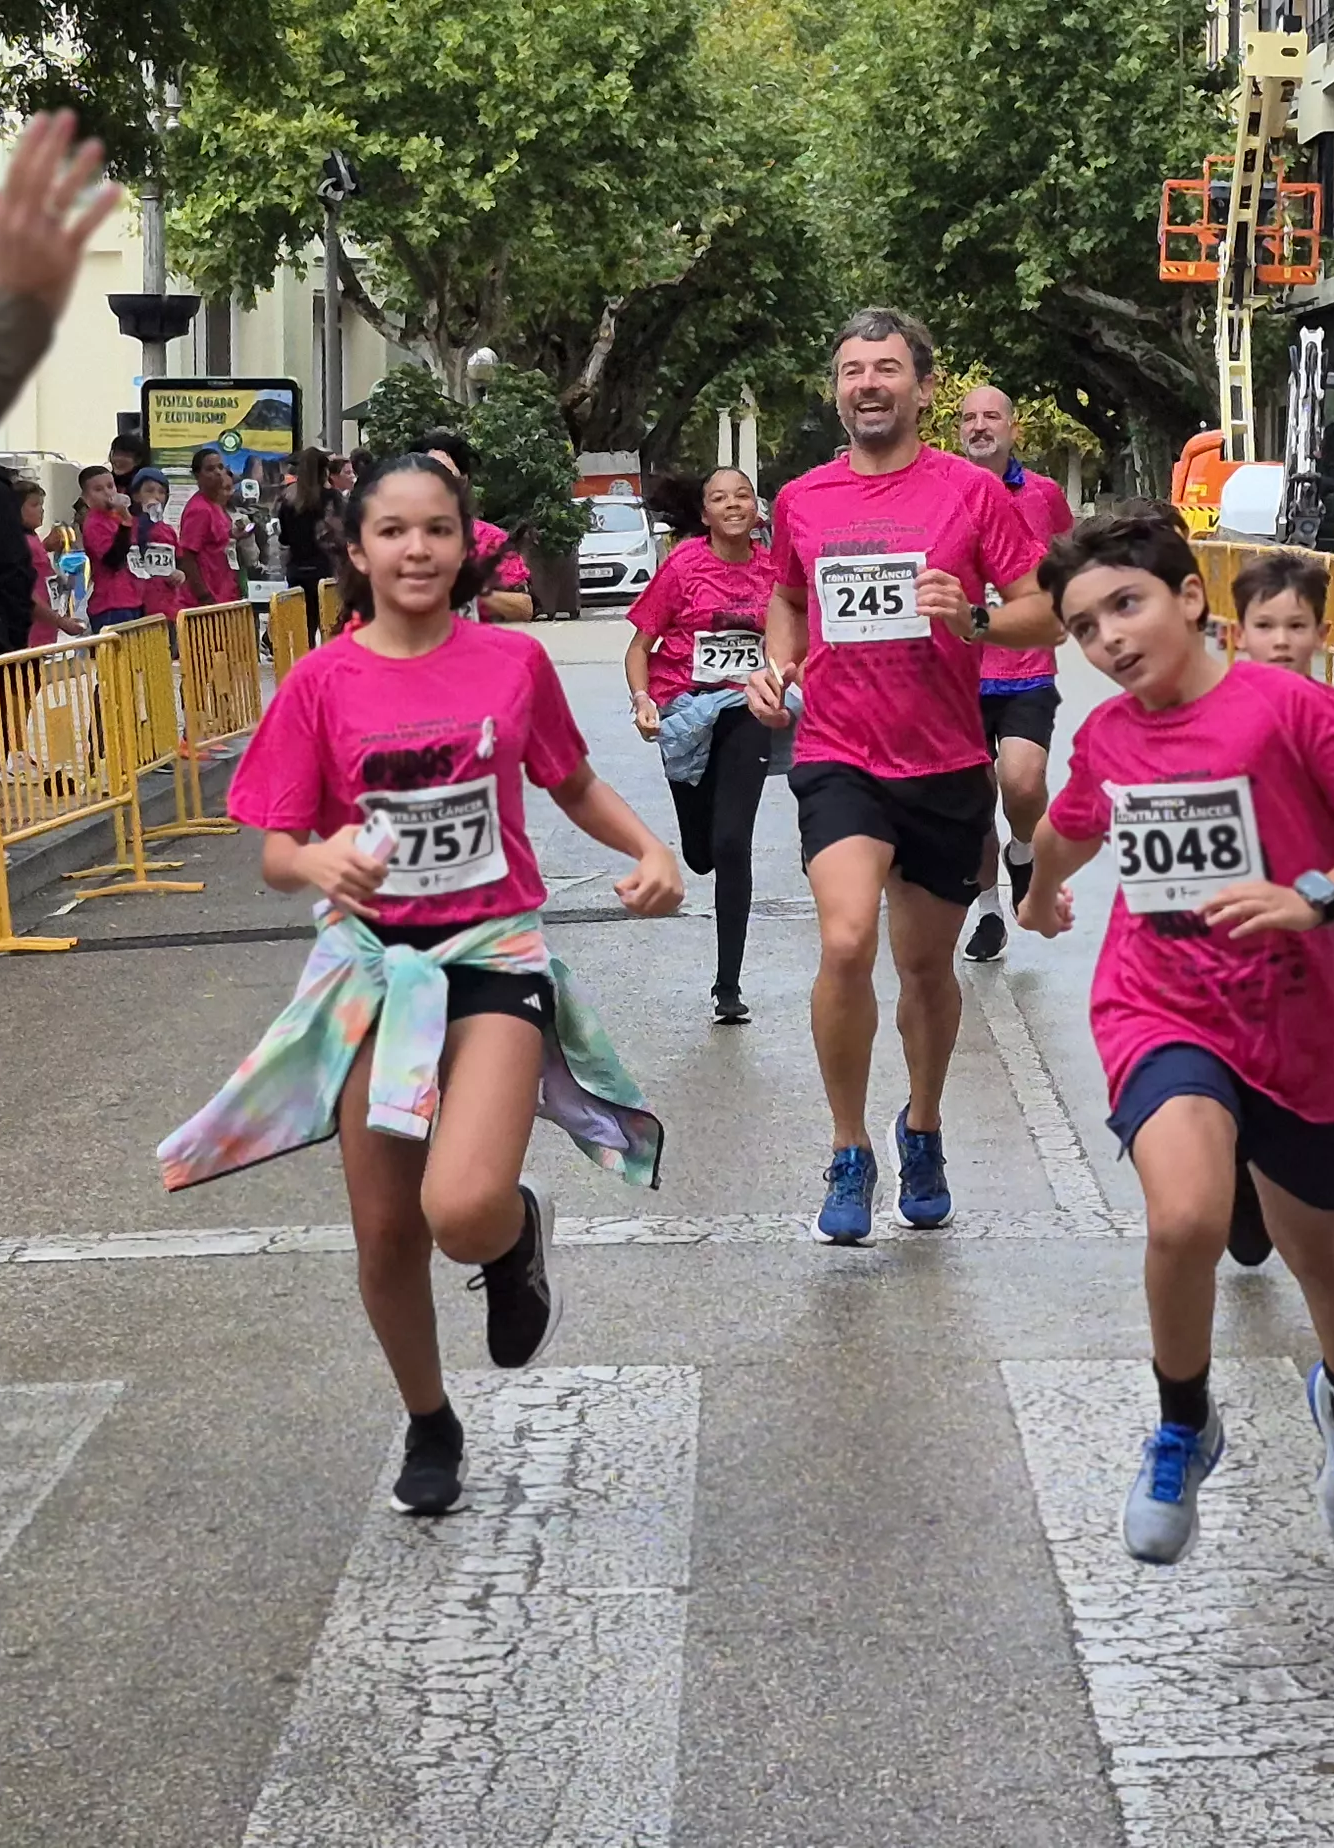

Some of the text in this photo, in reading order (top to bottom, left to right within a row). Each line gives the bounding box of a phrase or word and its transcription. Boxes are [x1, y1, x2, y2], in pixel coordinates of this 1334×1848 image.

[155, 395, 239, 409] VISITAS GUIADAS
[155, 412, 227, 425] Y ECOTURISMO
[863, 573, 873, 582] EL
[836, 584, 904, 618] 245
[703, 647, 759, 669] 2775
[422, 810, 436, 822] EL
[438, 800, 484, 820] CÁNCER
[1163, 808, 1177, 822] EL
[1180, 803, 1232, 820] CÁNCER
[387, 815, 487, 867] 757
[1117, 824, 1243, 877] 3048
